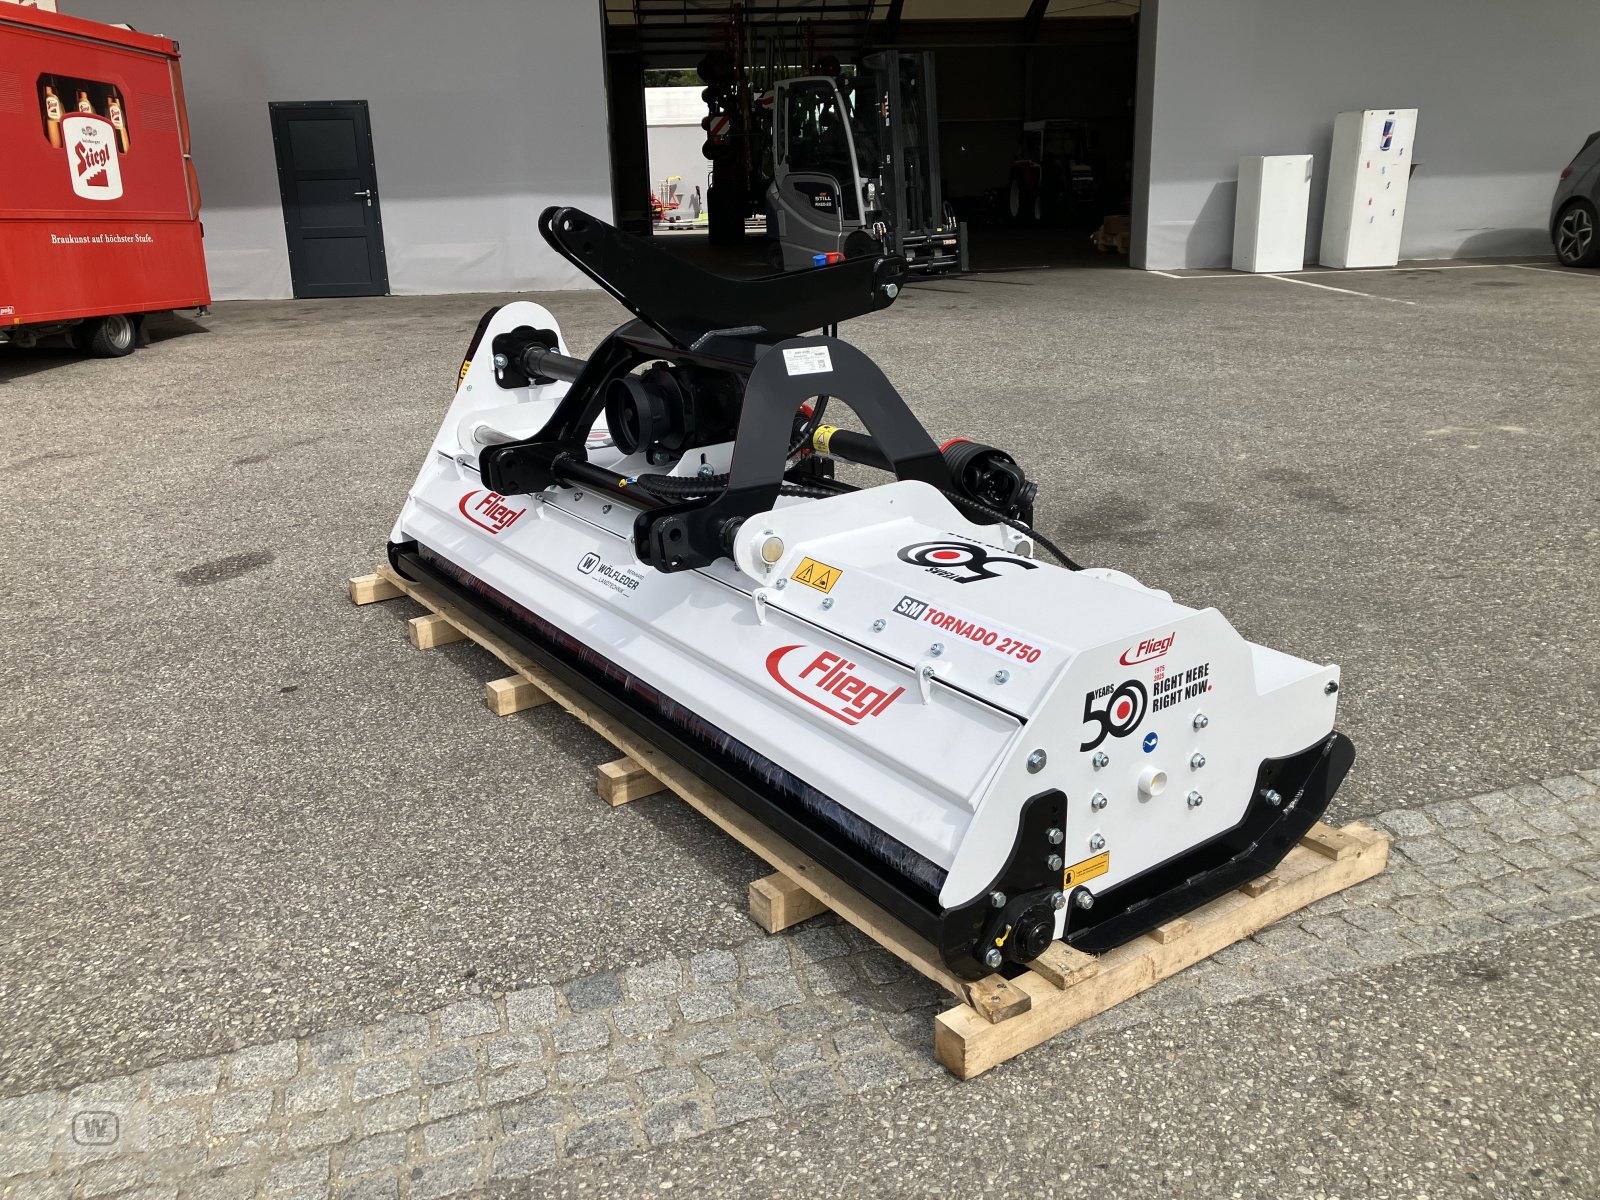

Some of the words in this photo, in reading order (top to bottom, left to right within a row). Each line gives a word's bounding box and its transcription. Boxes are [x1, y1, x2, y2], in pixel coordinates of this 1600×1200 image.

[74, 141, 110, 177] Stiegl
[51, 234, 90, 244] Braukunst
[91, 234, 103, 243] auf
[104, 233, 134, 243] höchster
[134, 233, 154, 243] Stufe.
[475, 491, 527, 531] Fliegl
[582, 556, 597, 570] W
[598, 563, 640, 591] WÖLFLEDER
[896, 598, 925, 619] SM
[923, 607, 998, 647] TORNADO
[995, 637, 1042, 664] 2750
[1135, 631, 1176, 658] Fliegl
[1153, 672, 1184, 697] RIGHT
[1186, 662, 1210, 684] HERE
[1154, 664, 1166, 675] 1975
[798, 650, 906, 720] Fliegl
[1094, 683, 1115, 700] YEARS
[1152, 688, 1183, 713] RIGHT
